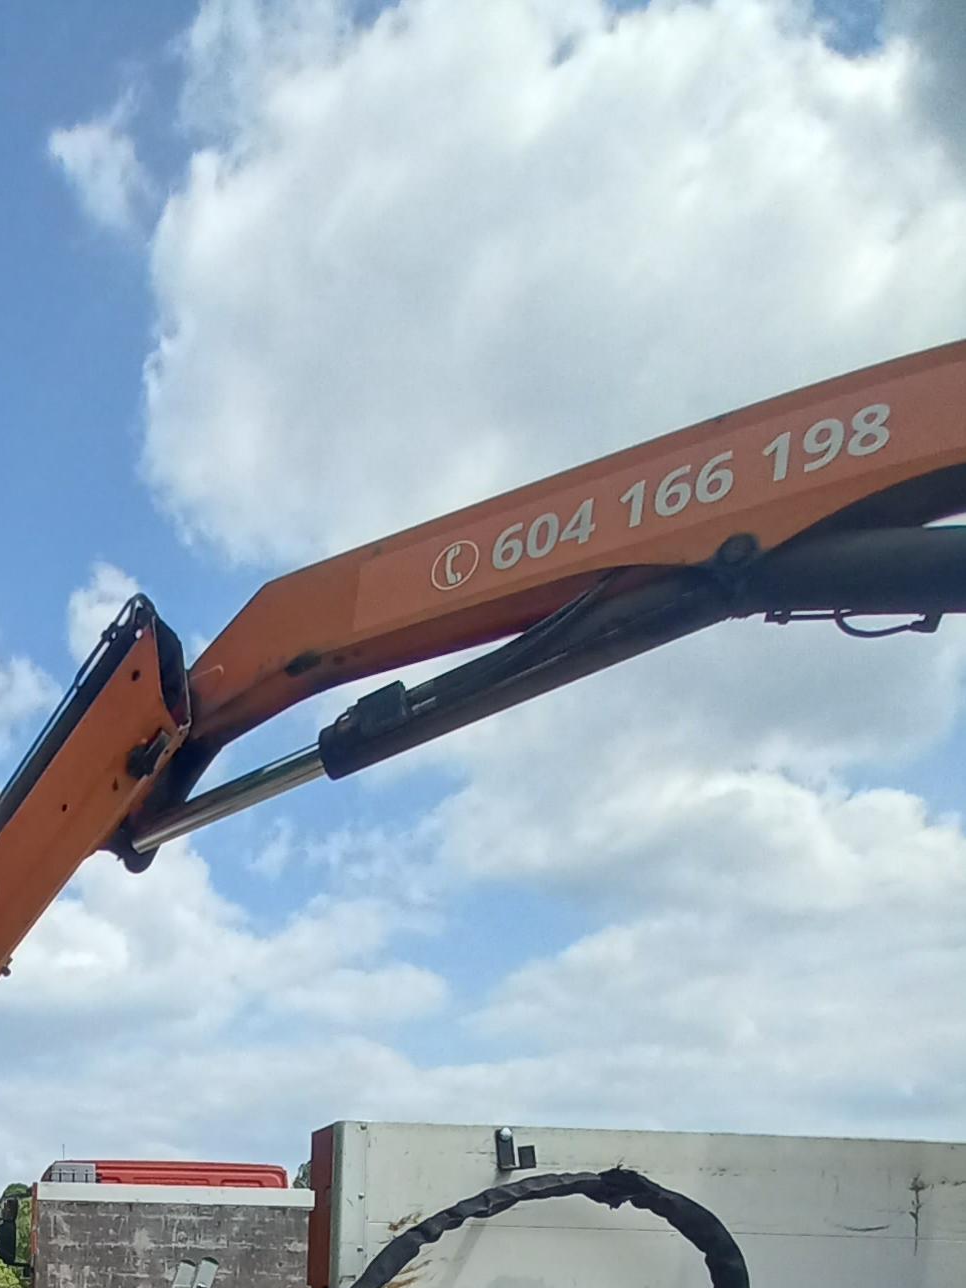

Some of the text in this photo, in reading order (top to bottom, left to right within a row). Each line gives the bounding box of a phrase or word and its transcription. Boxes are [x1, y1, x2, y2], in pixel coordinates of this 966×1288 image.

[491, 403, 891, 571] 604 166 198
